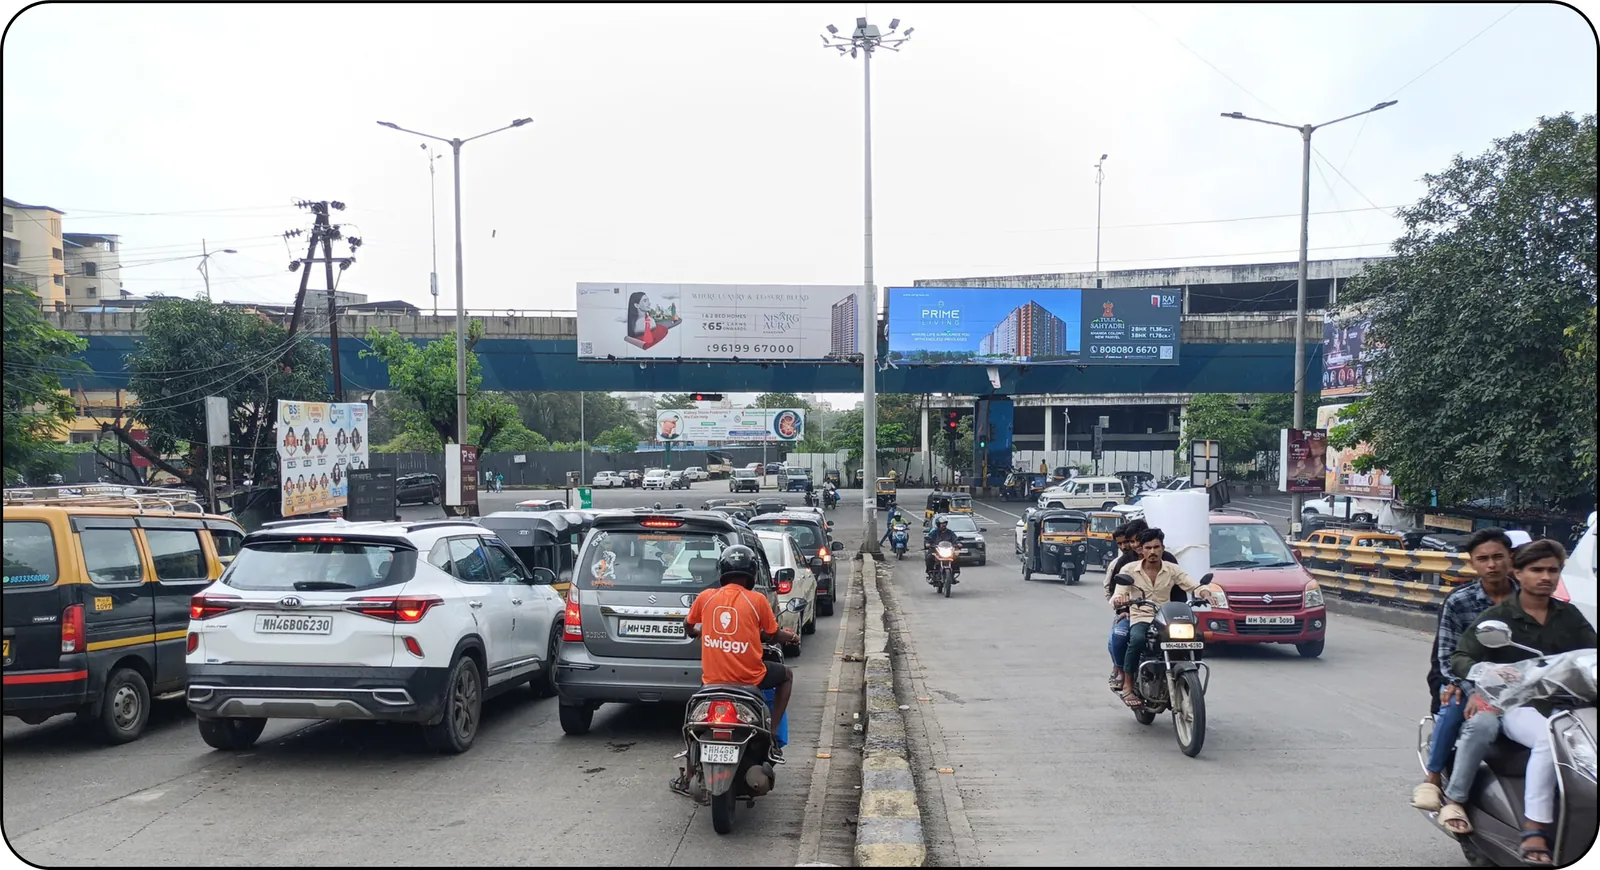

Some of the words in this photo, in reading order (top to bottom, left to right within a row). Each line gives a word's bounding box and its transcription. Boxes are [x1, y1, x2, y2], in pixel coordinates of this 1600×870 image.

[1162, 295, 1175, 304] RAJ
[921, 309, 960, 319] PRIME
[712, 344, 750, 353] 96199
[753, 344, 794, 353] 67000
[1099, 346, 1133, 354] 808080
[1136, 346, 1158, 354] 6670
[627, 624, 639, 633] MH
[640, 624, 651, 633] 43
[651, 625, 662, 633] AL
[662, 625, 684, 634] 6636
[704, 634, 749, 654] Swiggy
